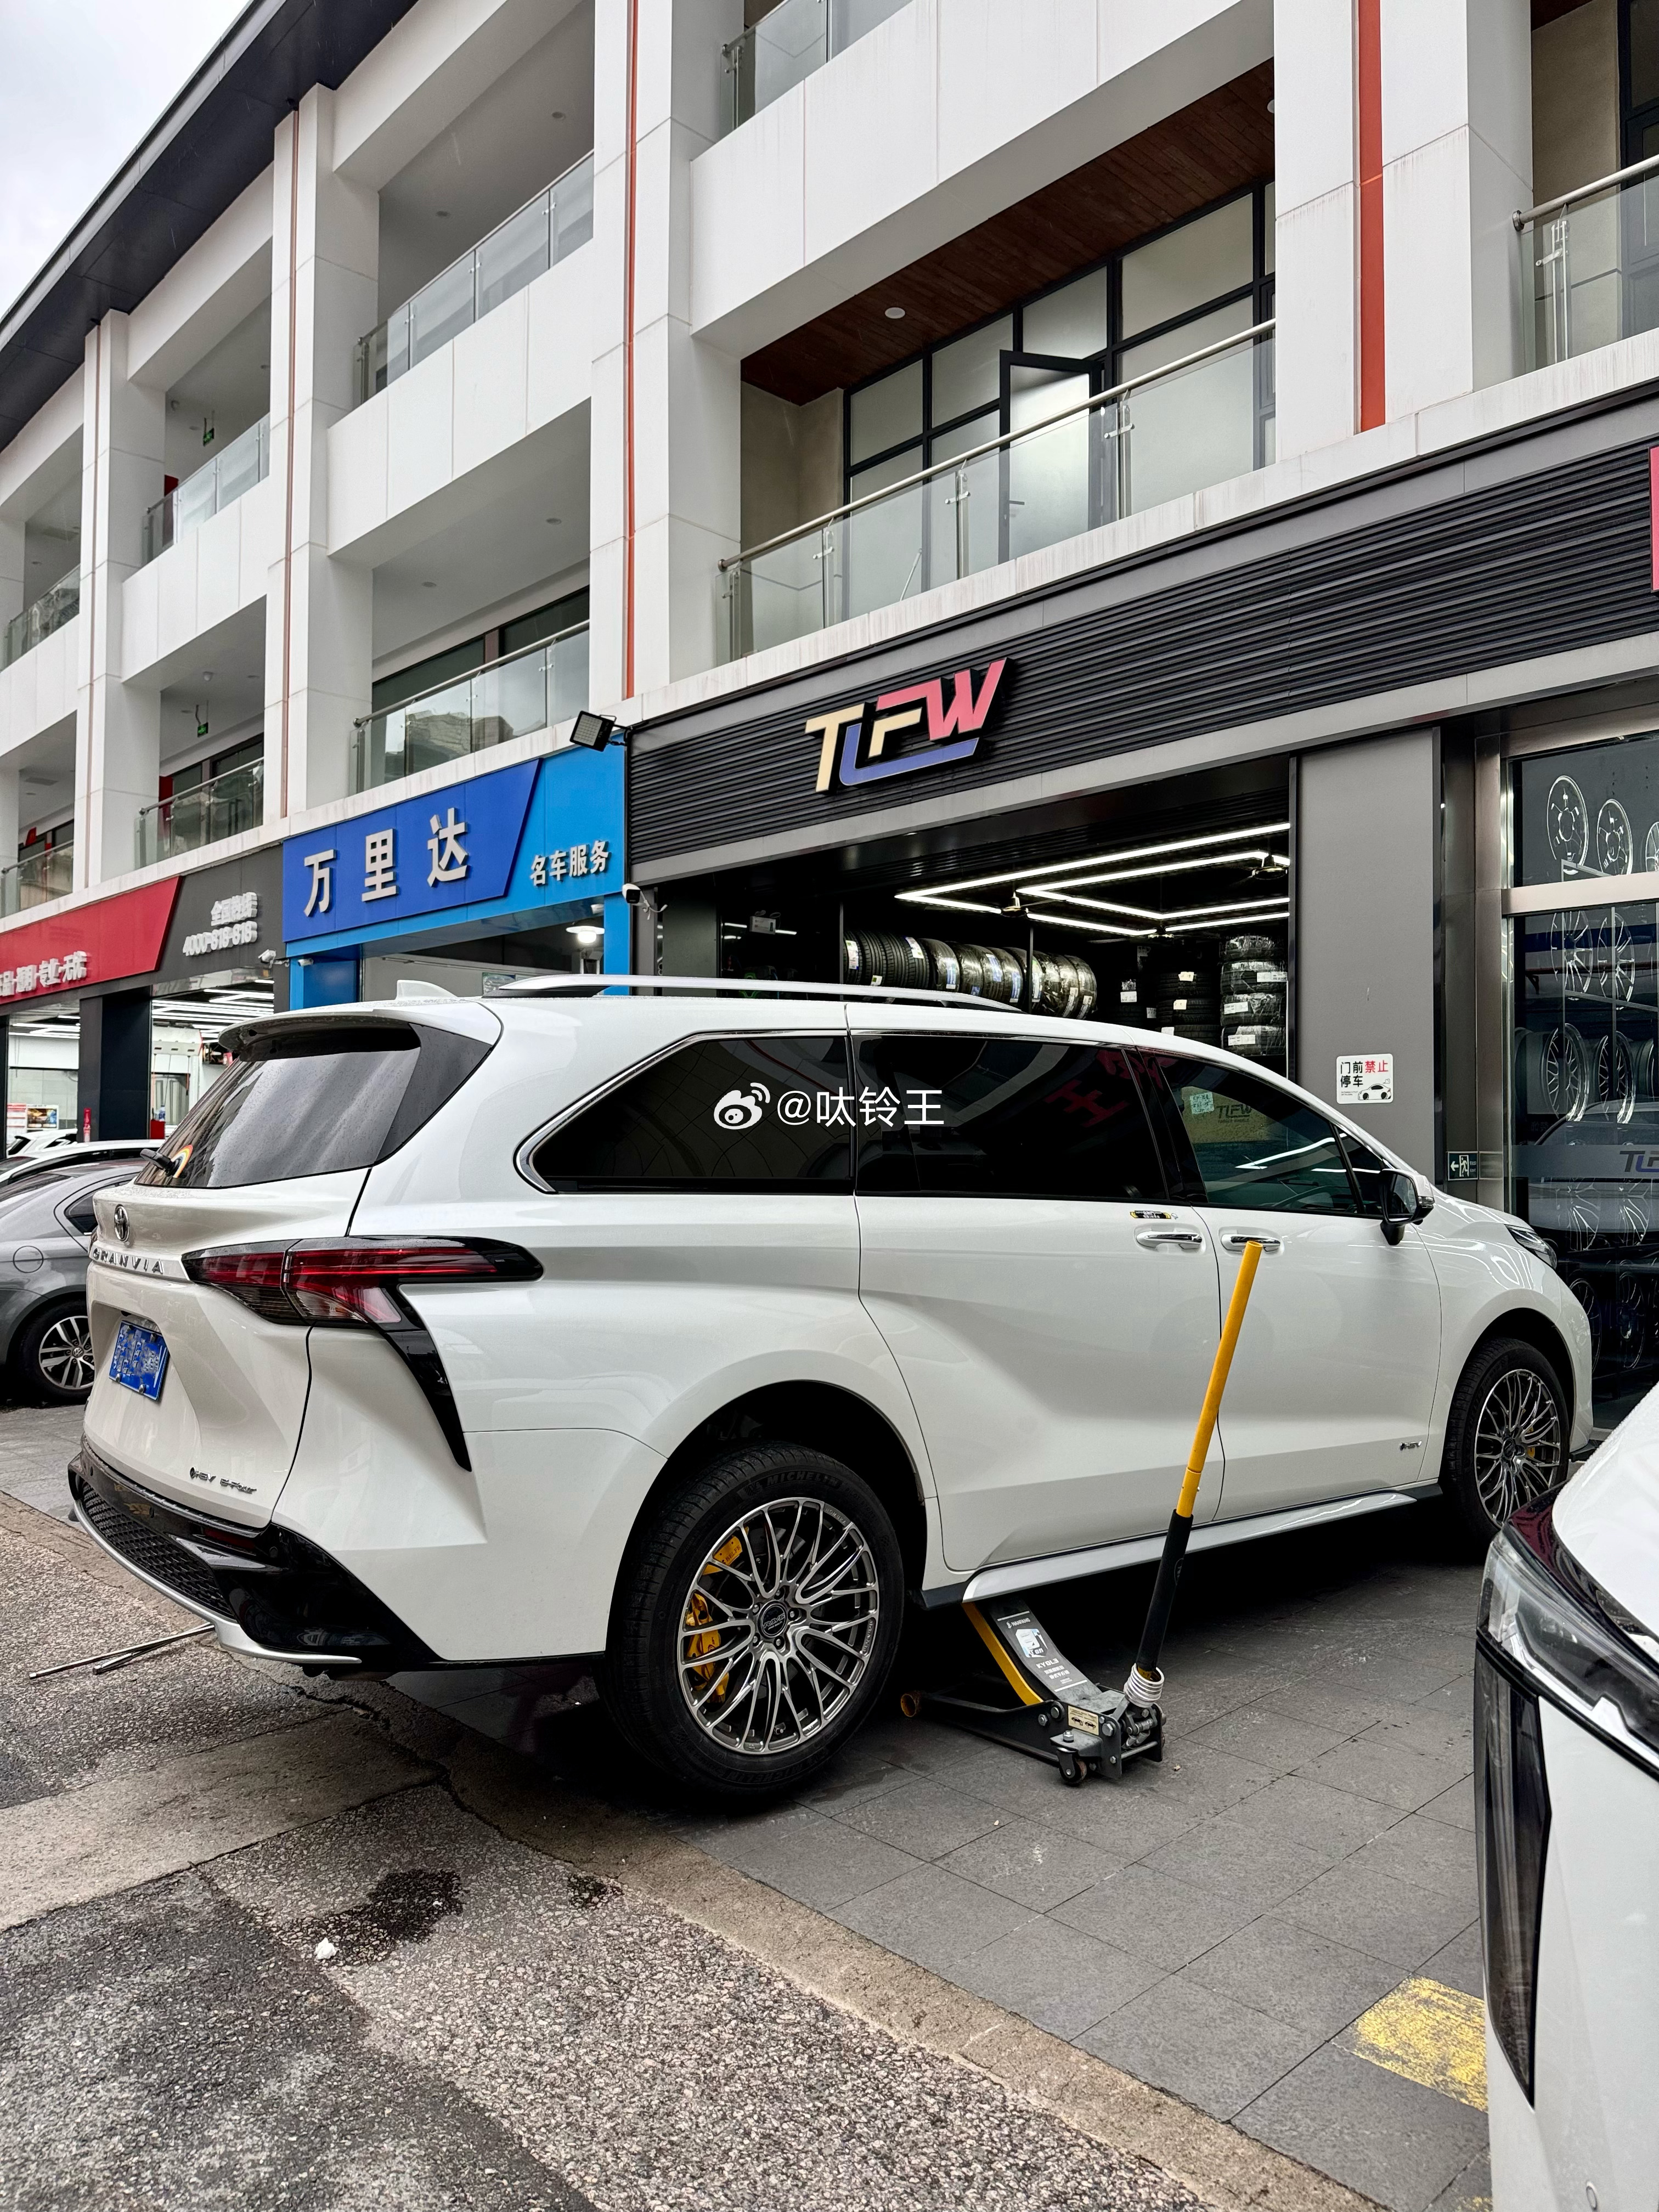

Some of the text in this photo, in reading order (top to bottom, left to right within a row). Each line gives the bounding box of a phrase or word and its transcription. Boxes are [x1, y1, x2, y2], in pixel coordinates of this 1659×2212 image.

[303, 807, 469, 917] 万里达
[530, 839, 610, 887] 名车服务
[1340, 1060, 1389, 1074] 门前禁止
[1340, 1075, 1363, 1088] 停车
[93, 1248, 165, 1275] GRANVIA
[766, 1470, 839, 1487] MICHELIN
